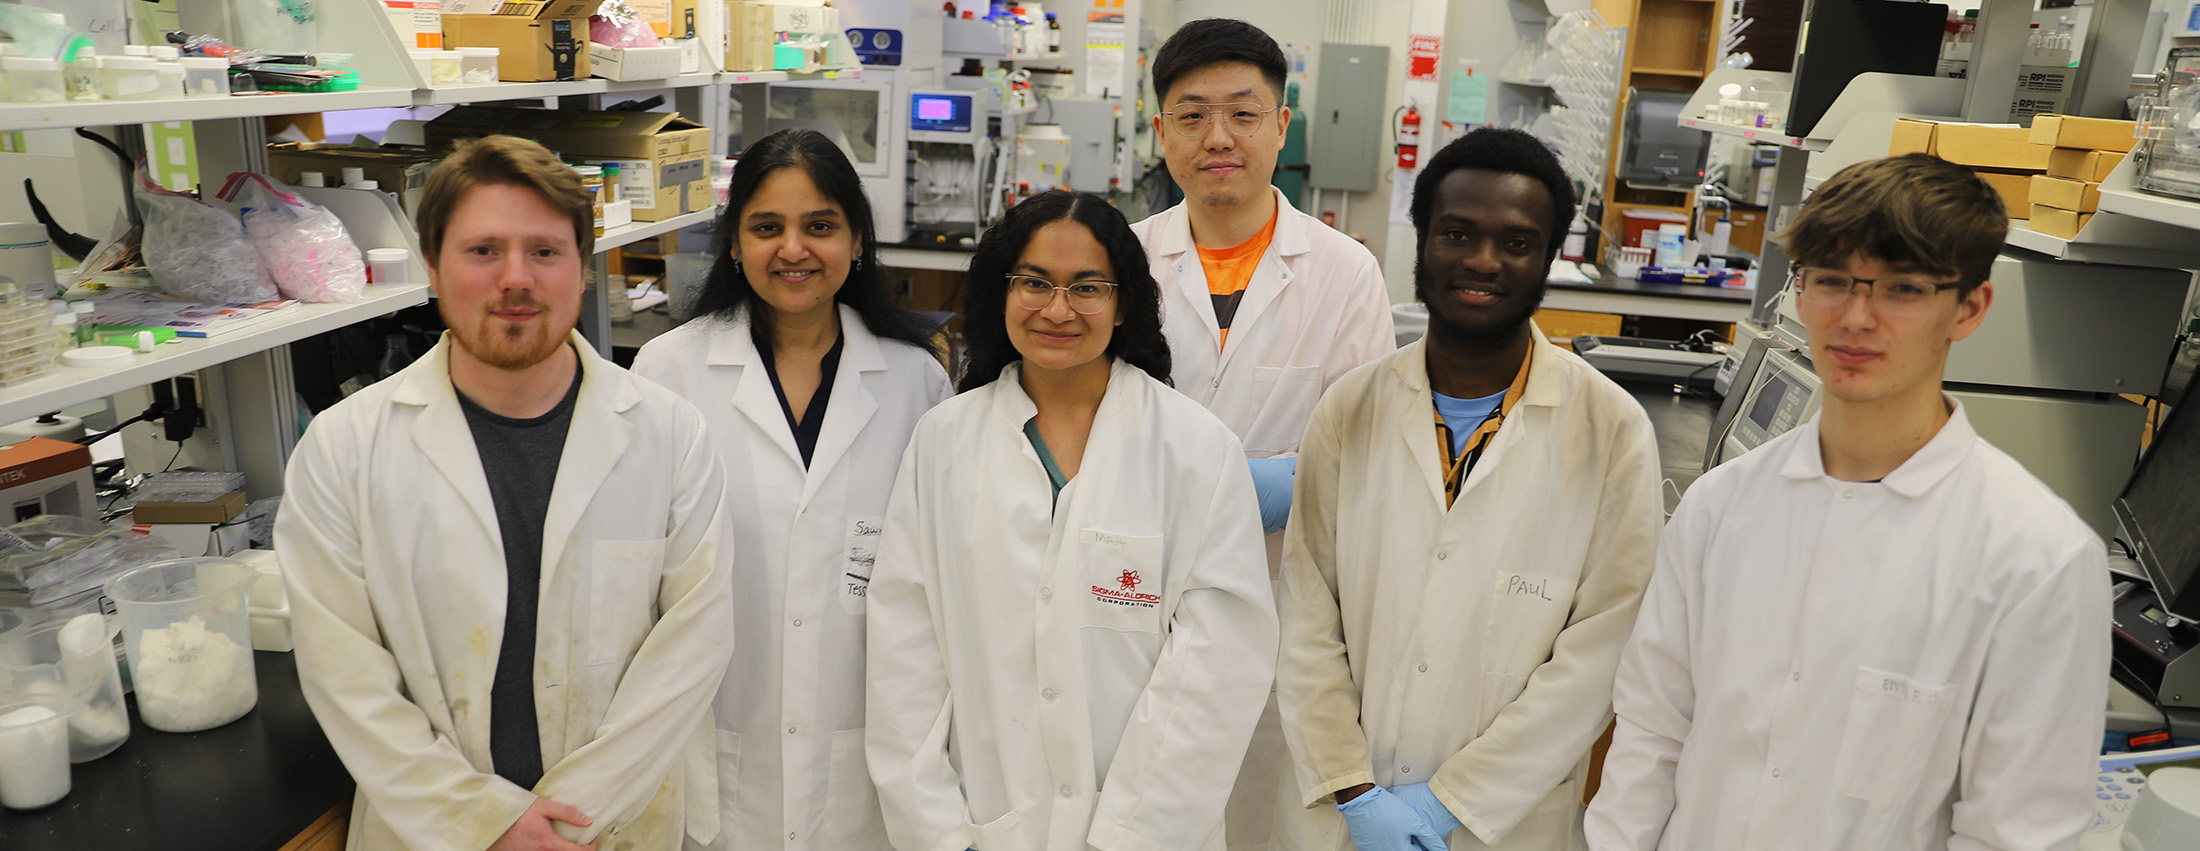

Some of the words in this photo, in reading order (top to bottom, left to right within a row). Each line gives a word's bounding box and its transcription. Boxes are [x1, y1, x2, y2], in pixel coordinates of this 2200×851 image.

[2030, 73, 2046, 81] RPI
[2019, 99, 2036, 108] RPI
[1091, 585, 1161, 601] SIGMA-ALDRICH
[1507, 575, 1551, 601] PAUL
[1096, 596, 1154, 609] CORPORATION
